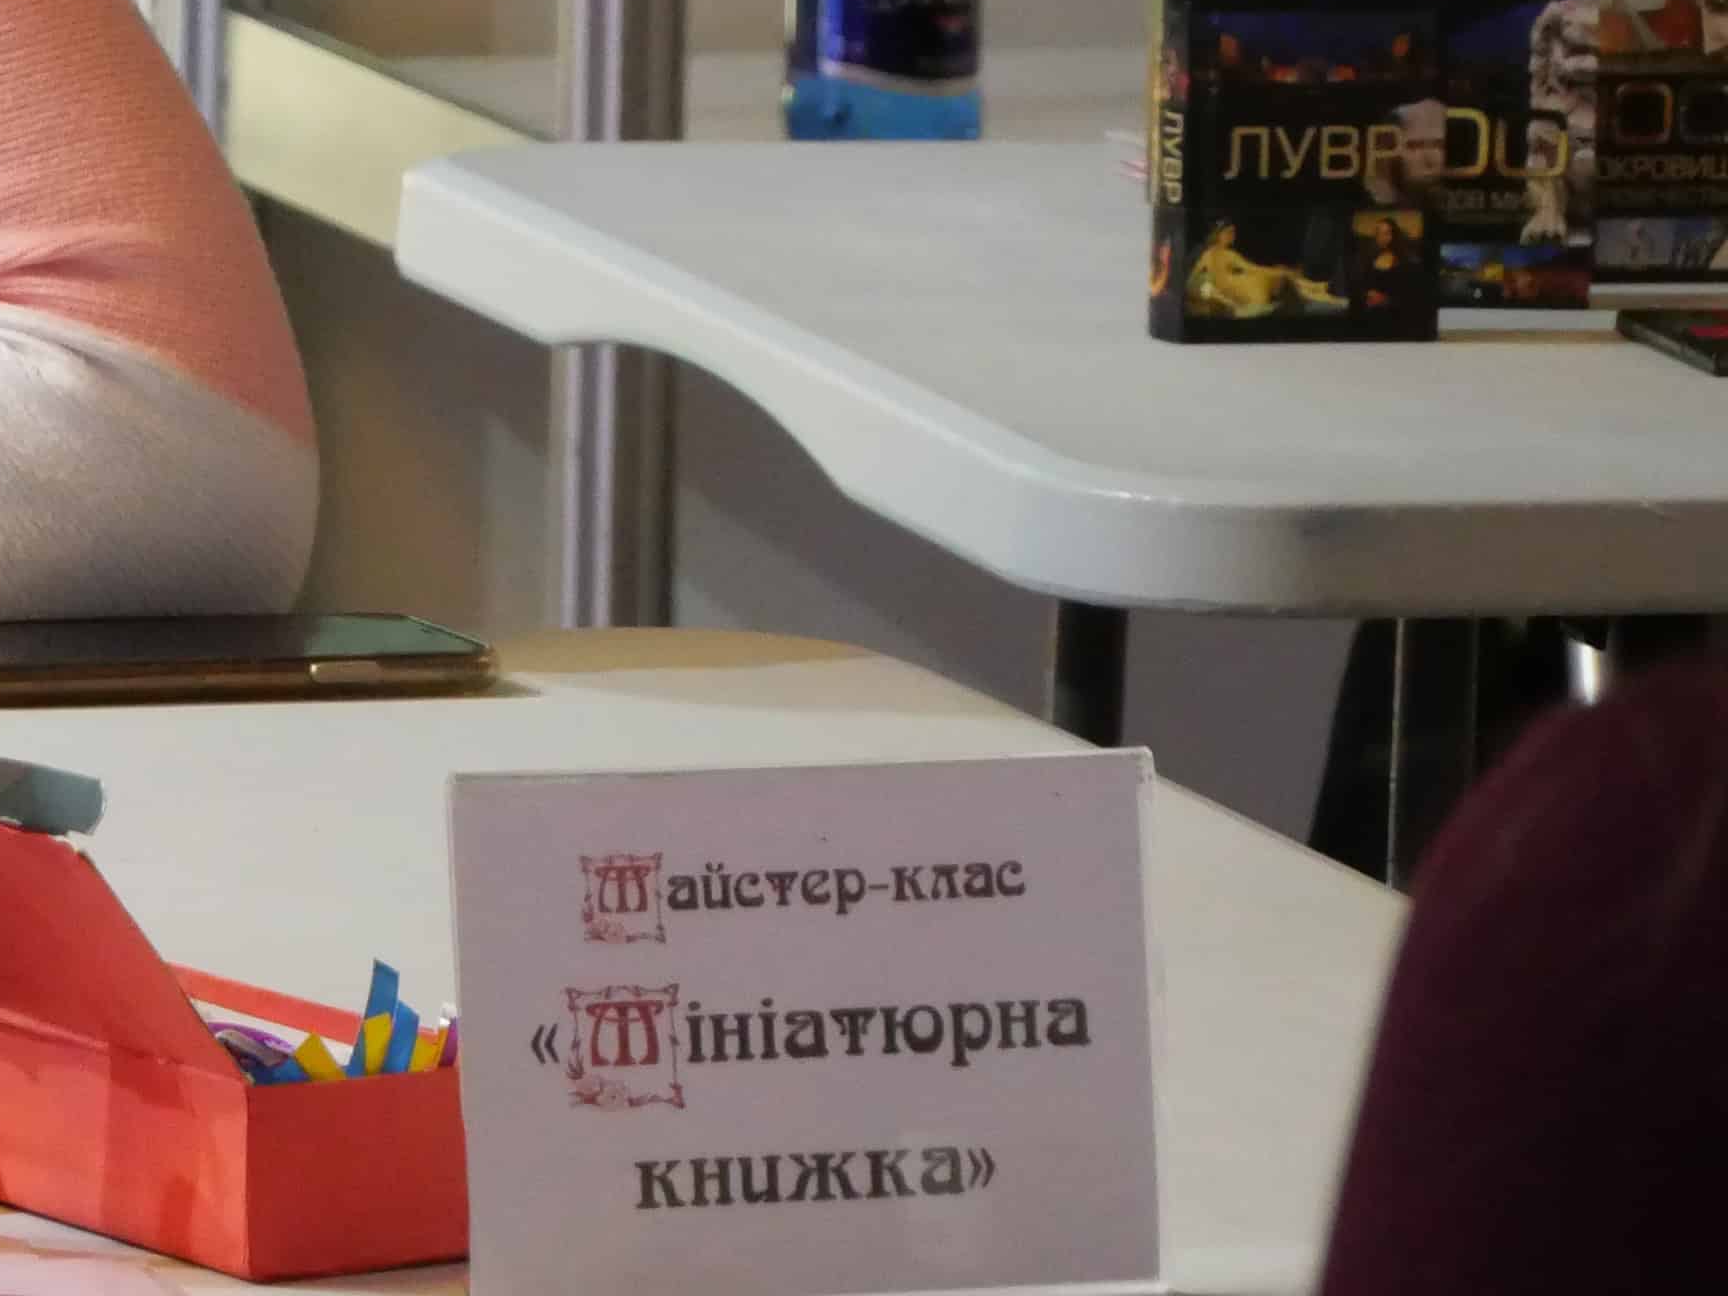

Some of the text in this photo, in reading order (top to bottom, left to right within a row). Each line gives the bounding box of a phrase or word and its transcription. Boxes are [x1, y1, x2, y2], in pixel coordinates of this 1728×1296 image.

[1224, 125, 1404, 180] ЛУВР
[582, 854, 1026, 926] Майстер-клас
[635, 1145, 996, 1210] книжка»
